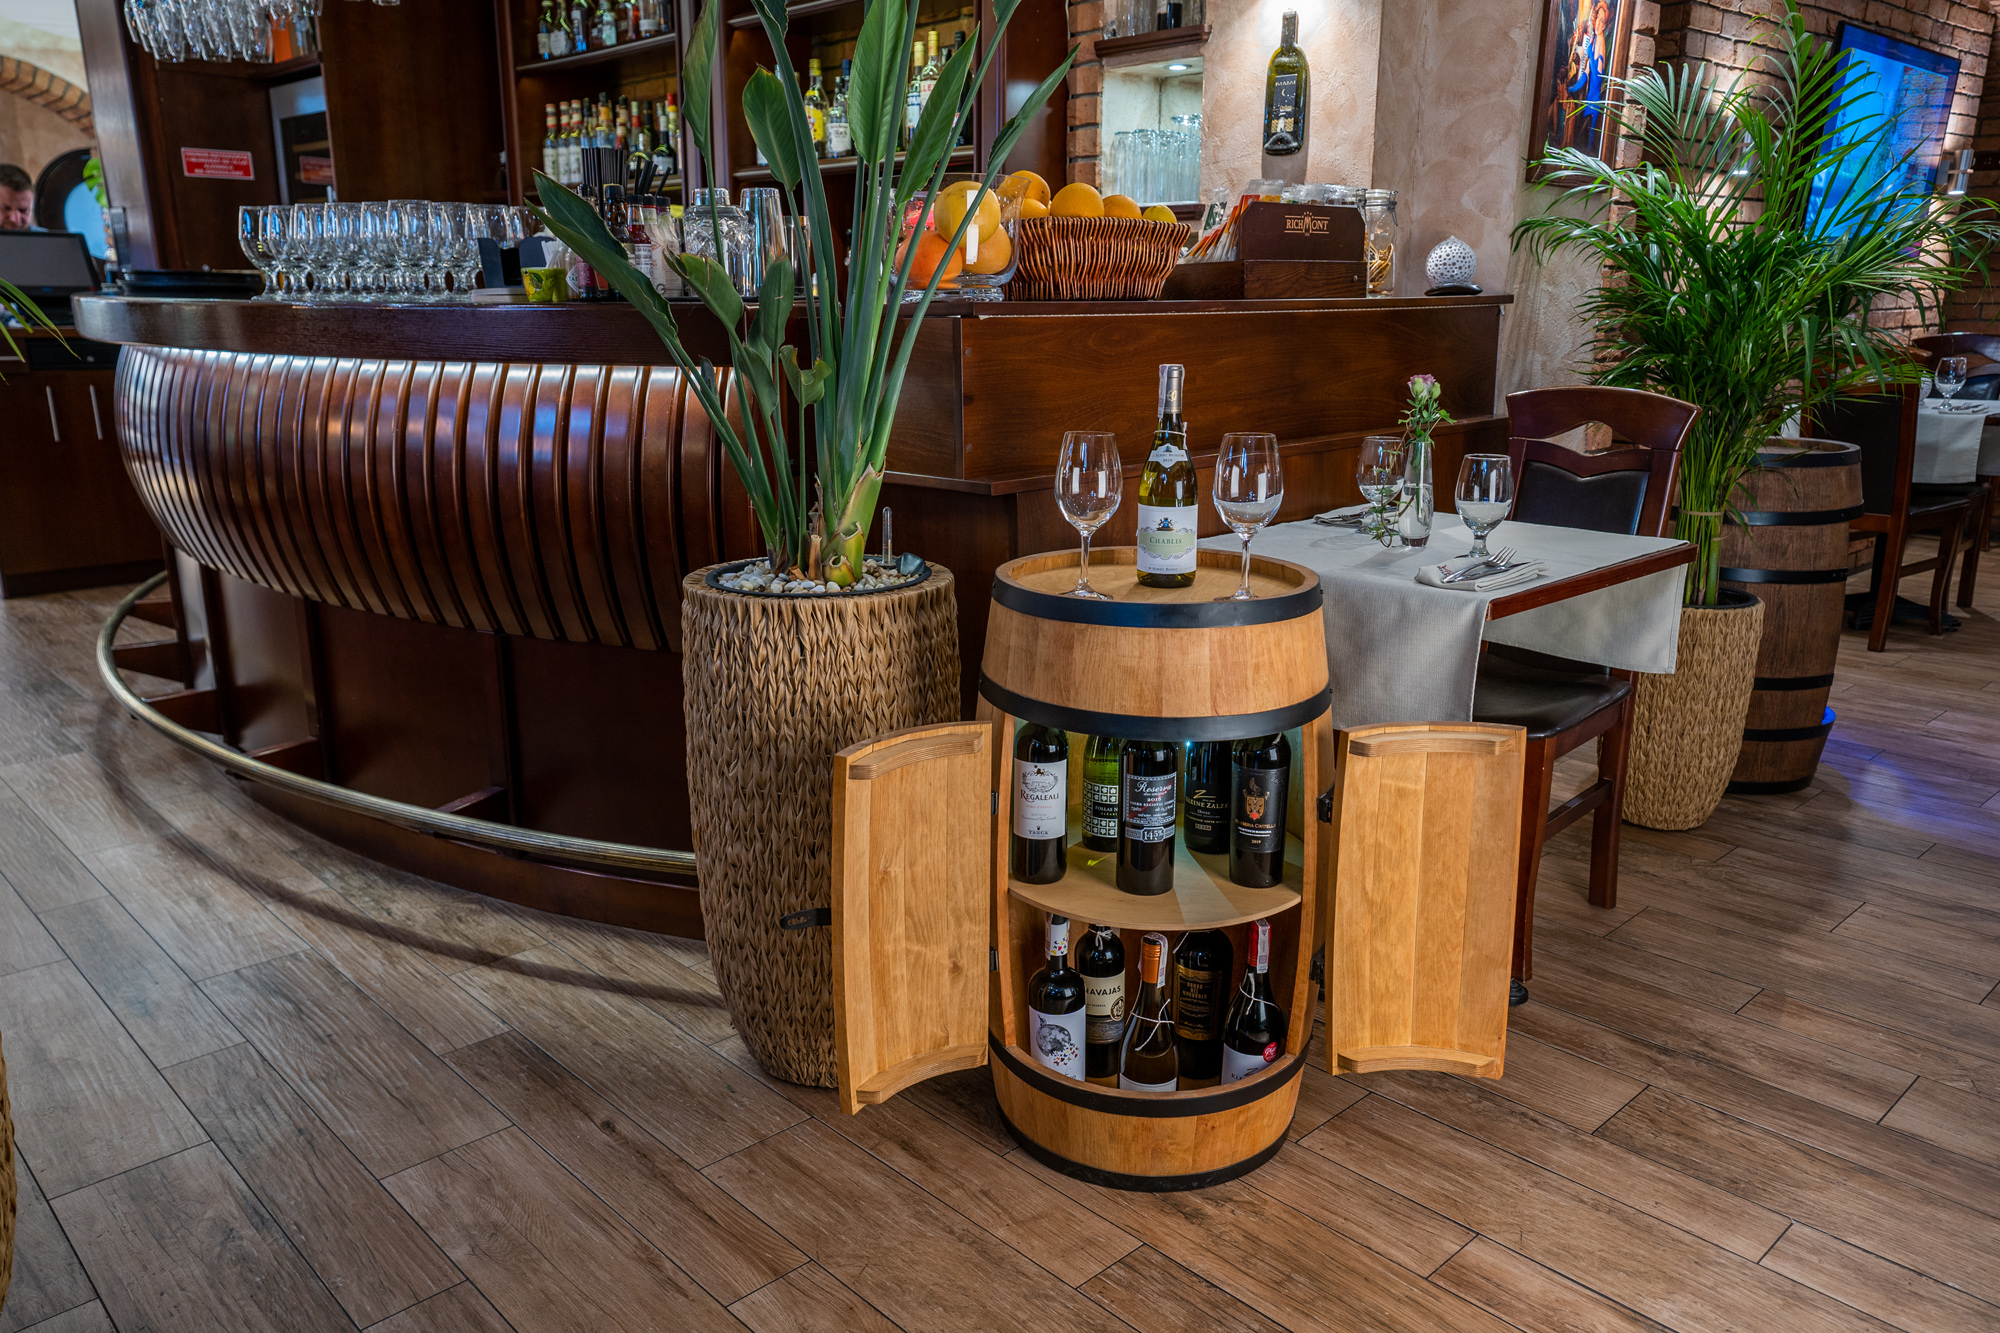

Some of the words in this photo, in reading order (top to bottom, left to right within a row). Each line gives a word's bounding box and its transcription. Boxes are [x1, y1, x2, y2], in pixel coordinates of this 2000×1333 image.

[1286, 214, 1329, 233] RICHMONT
[1149, 536, 1182, 545] CHABLIS
[1135, 781, 1173, 793] Reserva
[1020, 789, 1059, 803] REGALEALI
